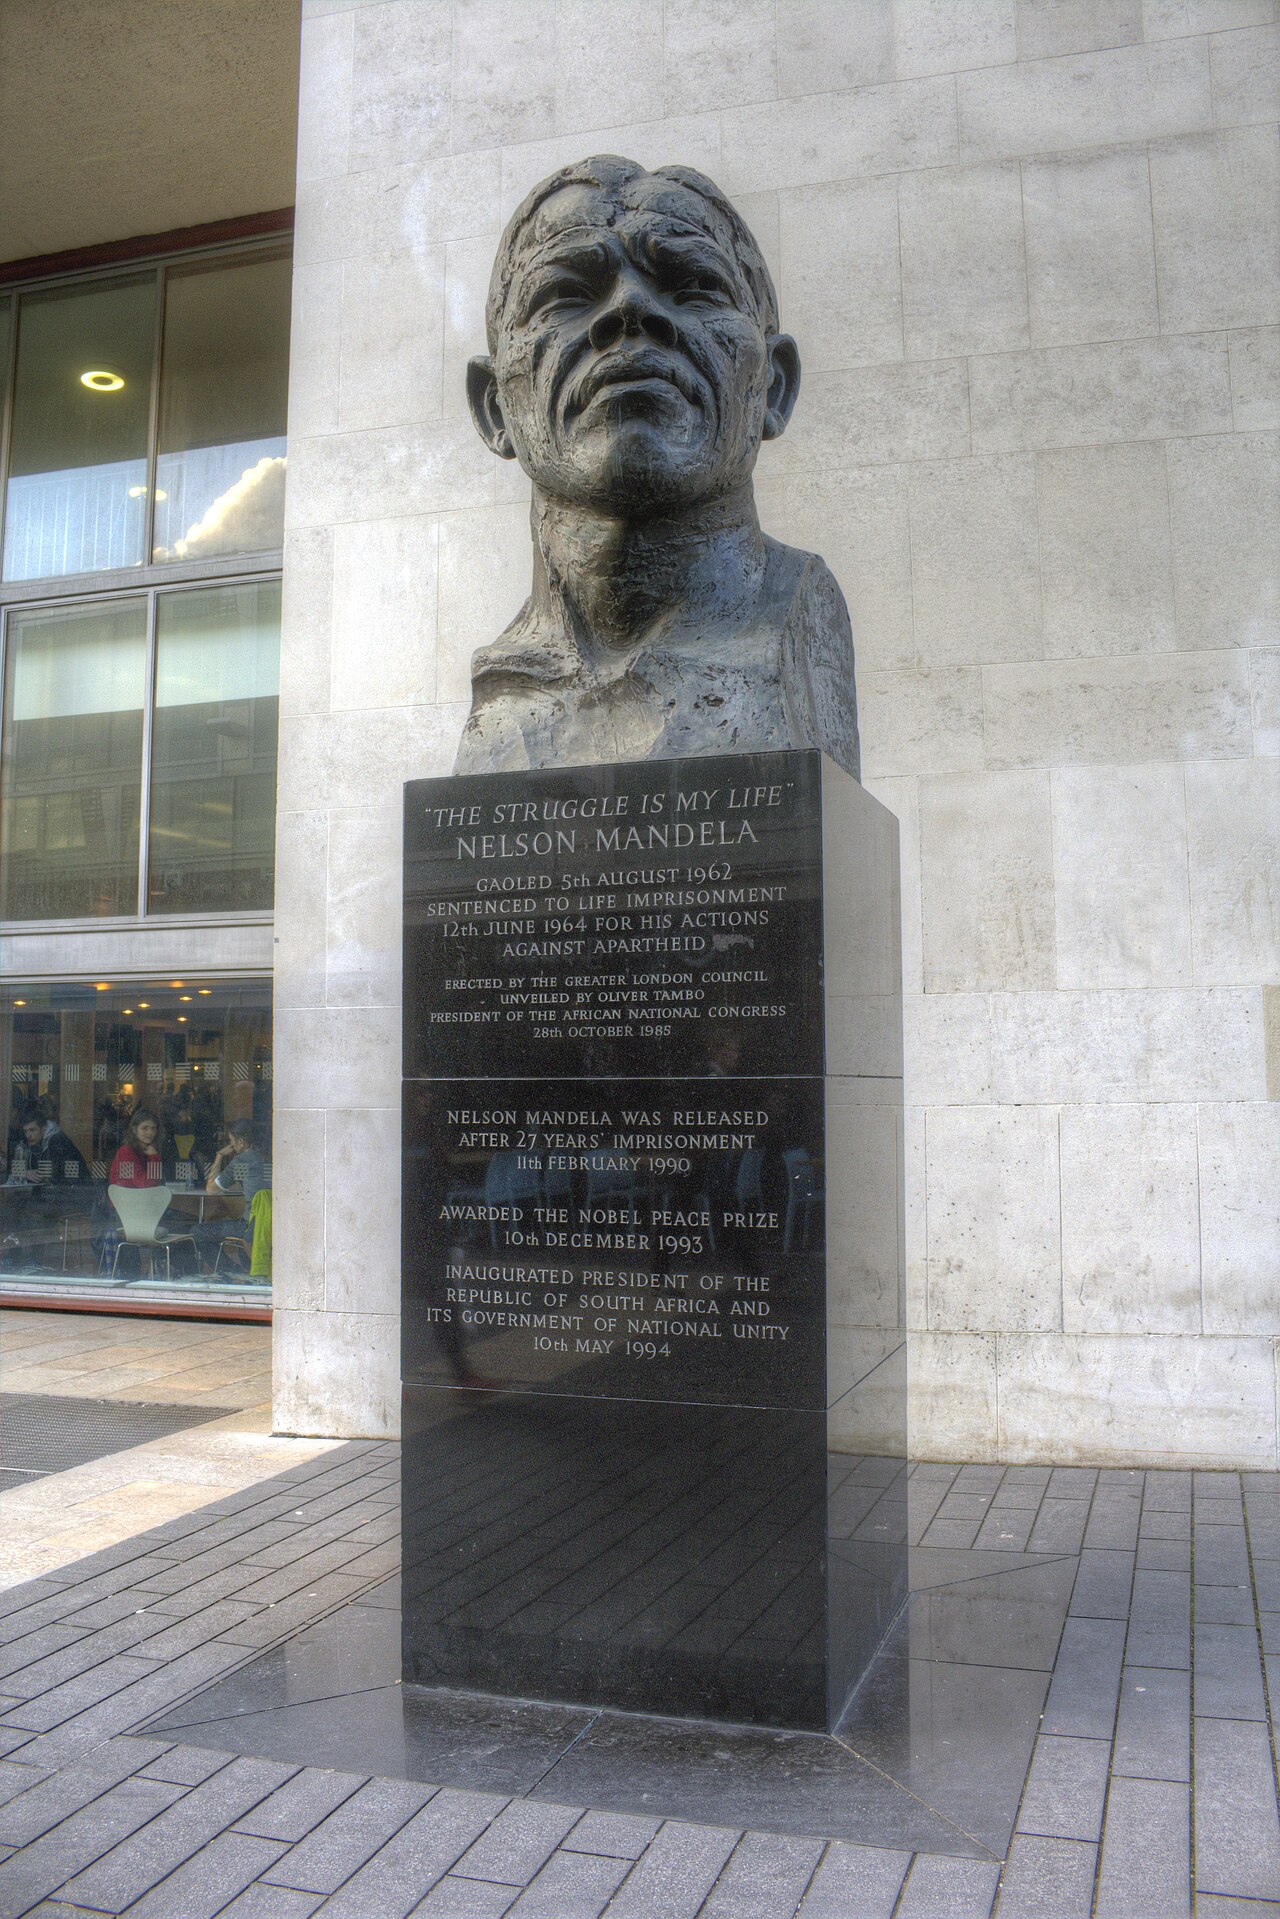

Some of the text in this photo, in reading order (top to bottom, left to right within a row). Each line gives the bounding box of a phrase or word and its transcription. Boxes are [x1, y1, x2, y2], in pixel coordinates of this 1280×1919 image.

[493, 797, 628, 824] STRUGGLE
[640, 794, 663, 814] IS
[671, 789, 719, 812] MY
[456, 819, 758, 859] NELSON MANDELA
[477, 863, 733, 892] GAOLED 5th AUGUST 1962
[427, 886, 787, 916] SENTENCED TO LIFE IMPRISONMENT
[443, 910, 769, 937] 12th JUNE 1964 FOR HIS ACTIONS
[502, 936, 705, 957] AGAINST APARTHEID
[445, 971, 767, 990] ERECTED BY THE GREATER LONDON COUNCIL
[500, 989, 705, 1005] UNVEILED BY OLIVER TAMBO
[430, 1005, 786, 1023] PRESIDENT OF THE AFRICAN NATIONAL CONGRESS
[533, 1025, 671, 1038] 28th OCTOBER 1985
[447, 1110, 769, 1126] NELSON MANDELA WAS RELEASED
[459, 1133, 510, 1148] AFTER
[516, 1131, 537, 1149] 27
[613, 1134, 755, 1150] IMPRISONMENT
[517, 1155, 690, 1174] 11th FEBRUARY 1990
[439, 1205, 779, 1228] AWARDED THE NOBEL PEACE PRIZE
[505, 1230, 704, 1254] 10th DECEMBER 1993
[445, 1264, 770, 1292] INAUGURATED PRESIDENT OF THE
[446, 1288, 770, 1316] REPUBLIC OF SOUTH AFRICA AND
[426, 1307, 790, 1340] ITS GOVERNMENT OF NATIONAL UNITY
[533, 1336, 671, 1359] 10th MAY 1994
